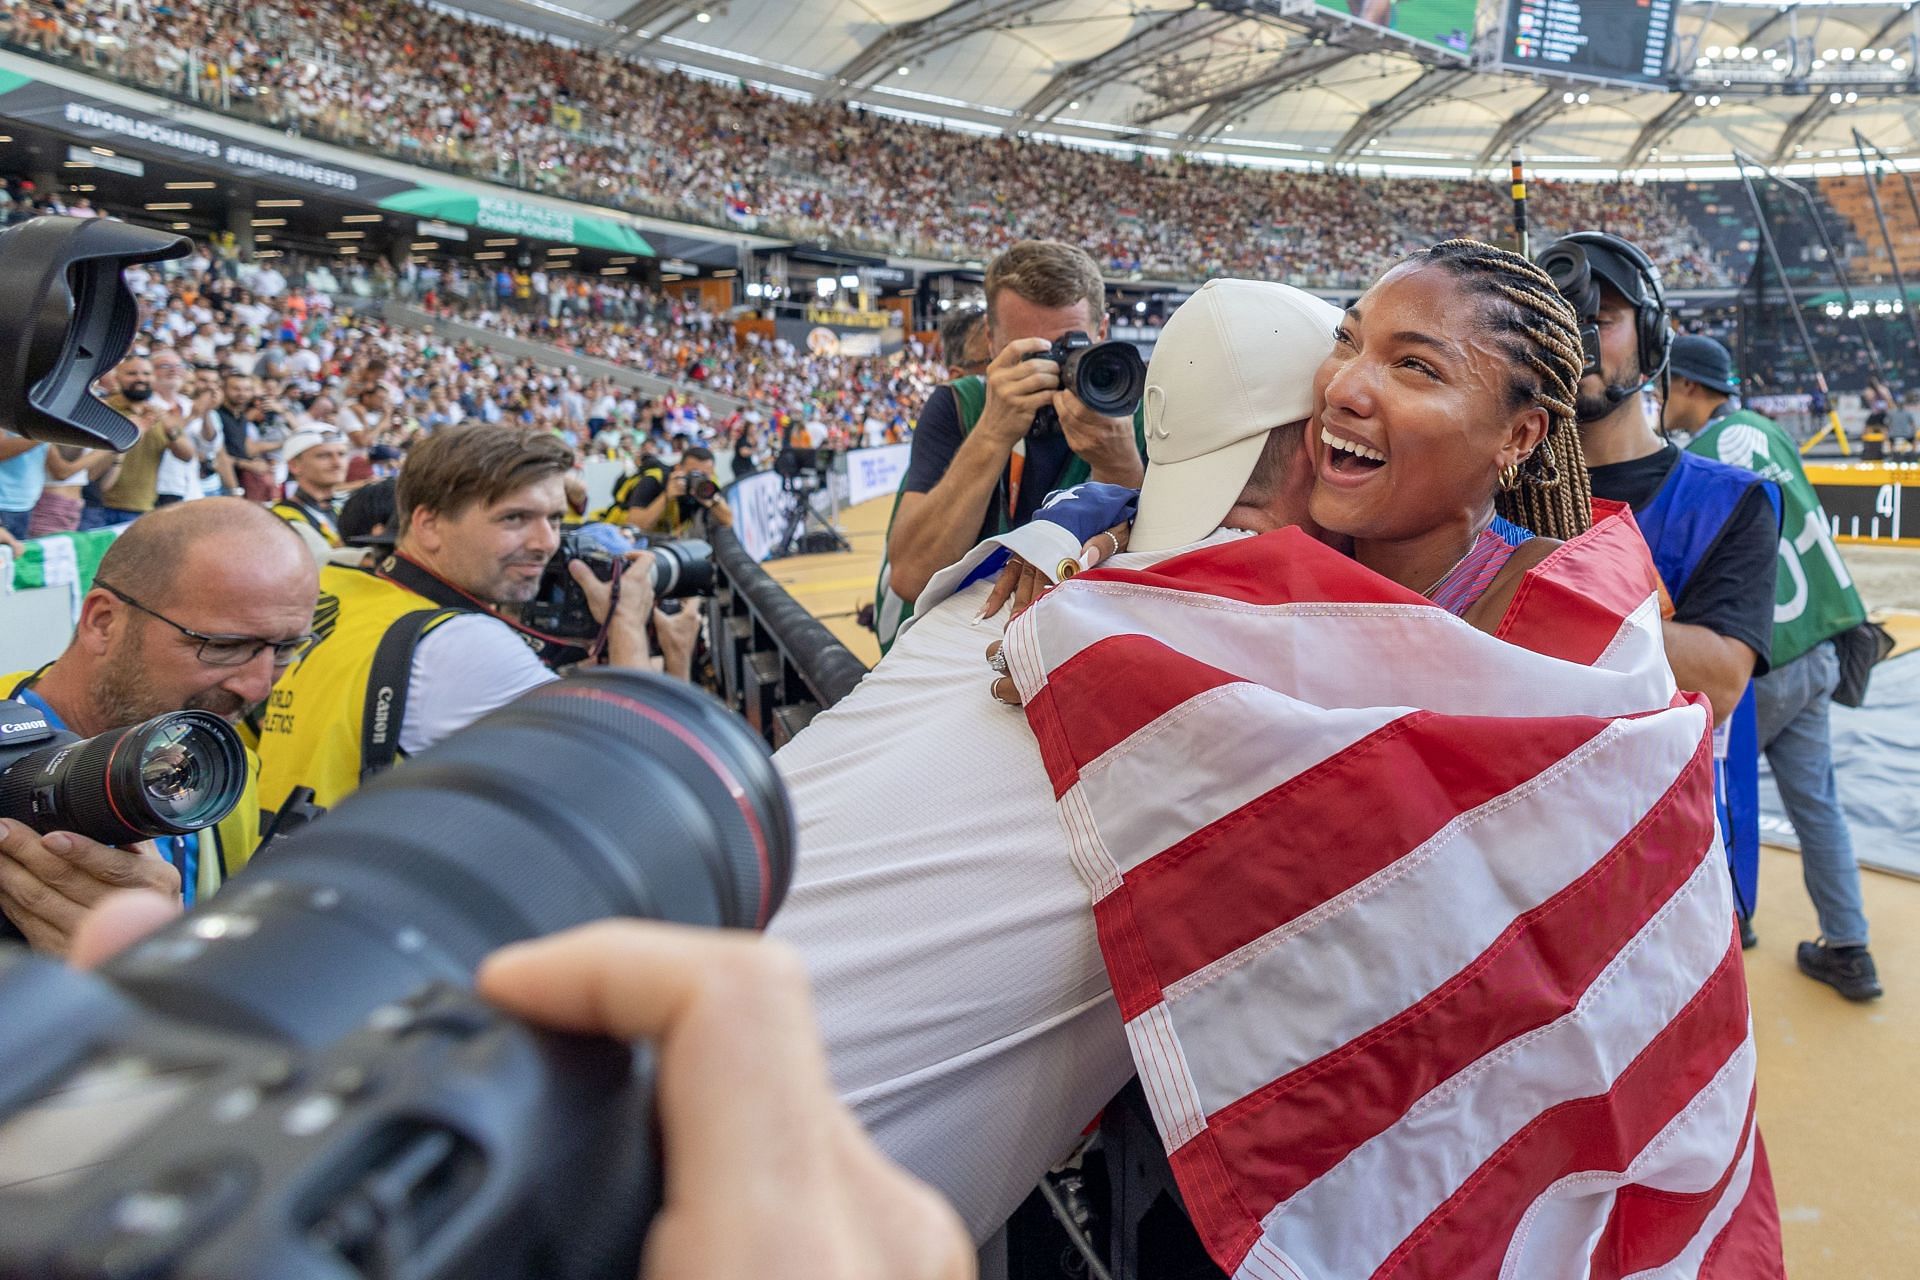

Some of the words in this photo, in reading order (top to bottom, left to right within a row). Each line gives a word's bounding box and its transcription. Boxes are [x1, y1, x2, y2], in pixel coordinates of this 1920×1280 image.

[270, 690, 294, 709] ORLD
[372, 686, 394, 744] Canon
[0, 719, 48, 734] Canon
